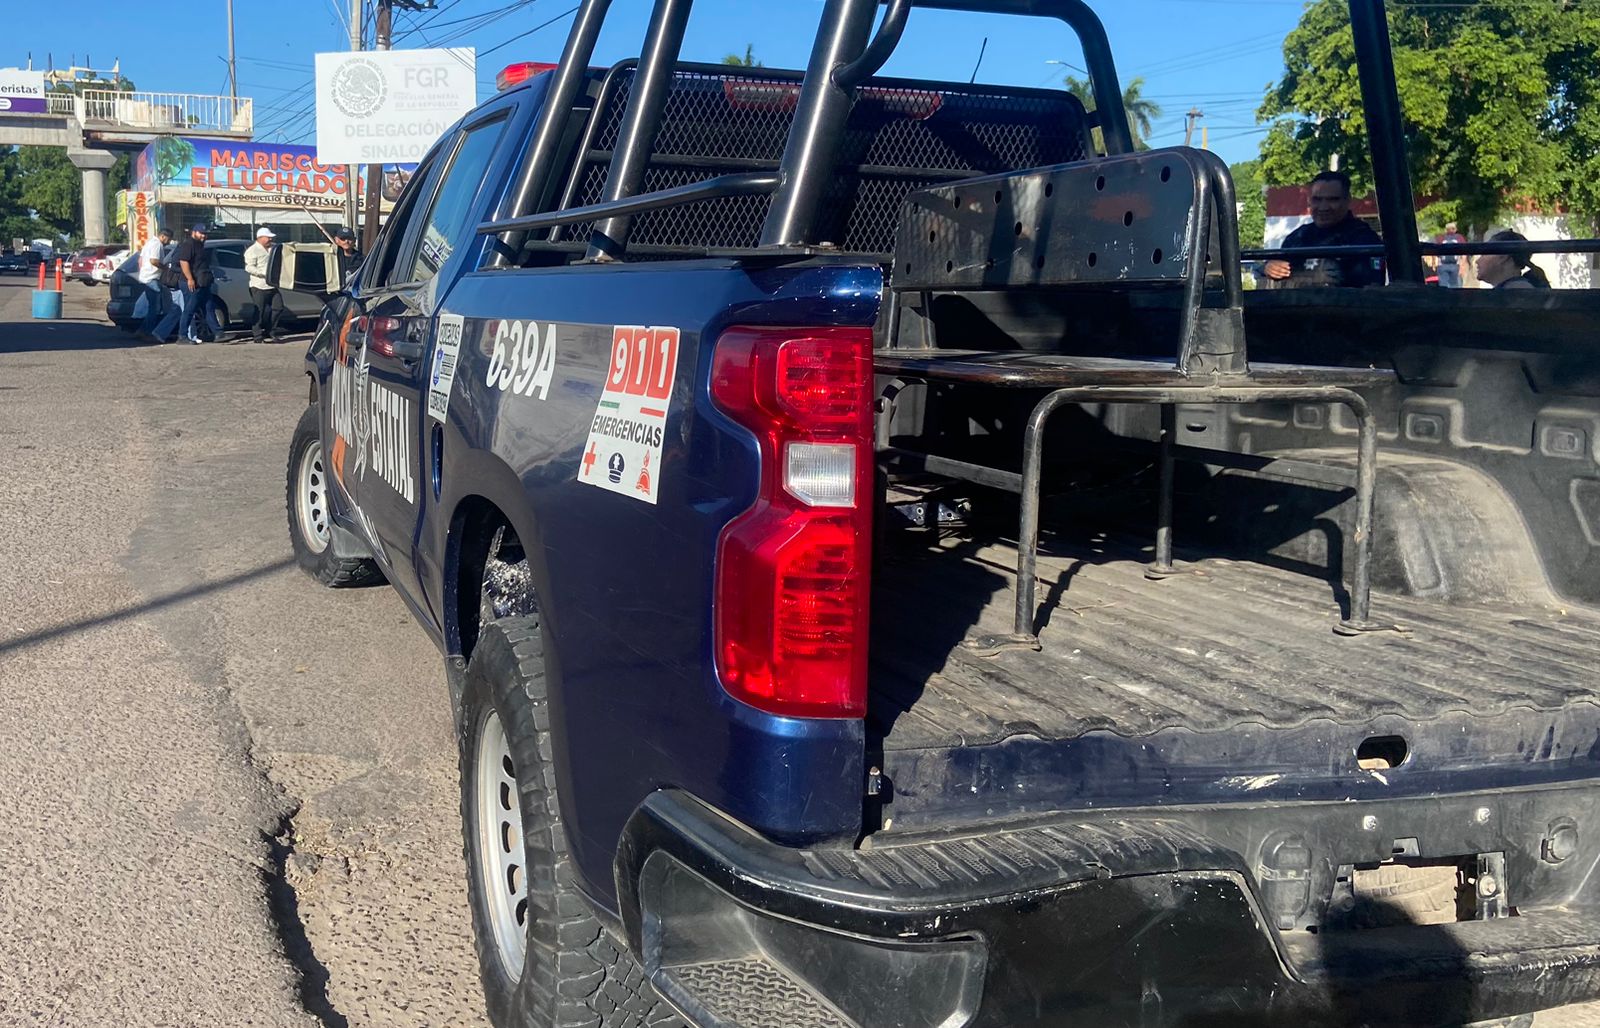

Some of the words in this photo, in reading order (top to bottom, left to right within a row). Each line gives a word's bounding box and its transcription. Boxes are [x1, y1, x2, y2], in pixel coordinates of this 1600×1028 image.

[1, 84, 38, 94] eristas
[404, 67, 449, 88] FGR
[344, 119, 446, 138] DELEGACIÓN
[210, 148, 346, 174] MARISCOS
[190, 167, 222, 188] EL
[191, 192, 229, 200] SERVICIO
[486, 319, 556, 401] 639A
[612, 338, 670, 389] 911
[371, 381, 414, 504] ESTATAL
[591, 414, 662, 448] EMERGENCIAS
